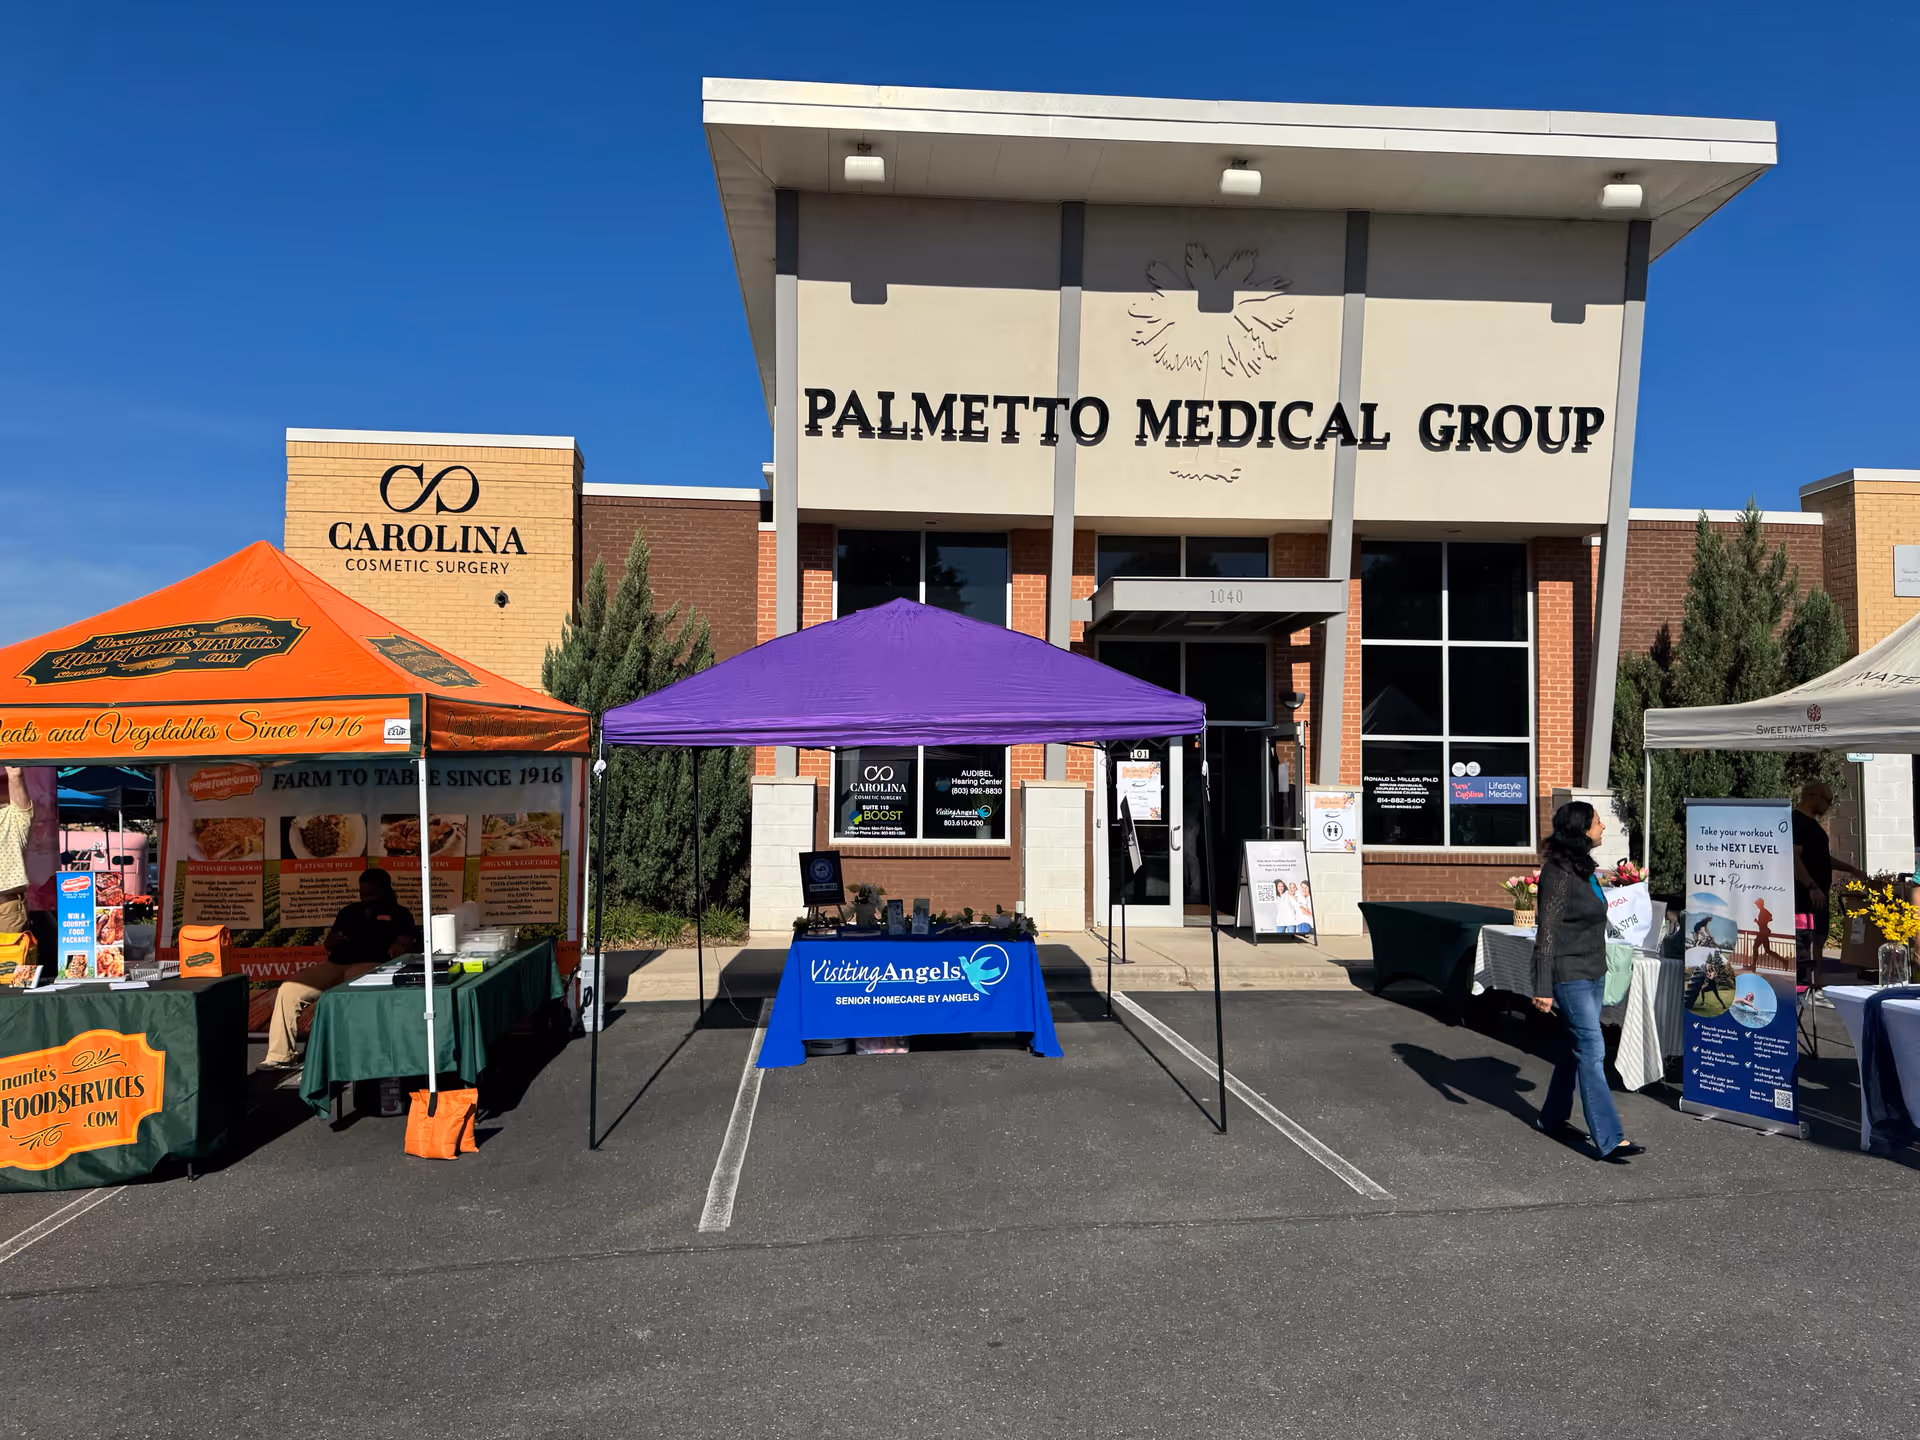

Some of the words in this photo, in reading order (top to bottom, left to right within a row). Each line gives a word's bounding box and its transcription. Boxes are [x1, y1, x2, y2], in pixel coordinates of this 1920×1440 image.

[804, 387, 1110, 447] PALMETTO
[1134, 397, 1391, 451] MEDICAL
[1418, 402, 1605, 454] GROUP
[328, 521, 527, 556] CAROLINA
[345, 558, 429, 572] COSMETIC
[436, 560, 510, 575] SURGERY
[1211, 588, 1243, 604] 1040
[0, 720, 40, 743] eats
[47, 719, 91, 742] and
[93, 711, 220, 751] Vegetables
[224, 710, 299, 742] Since
[304, 716, 364, 740] 1916
[1131, 750, 1148, 759] 101
[272, 770, 330, 791] FARM
[337, 768, 367, 786] TO
[447, 768, 511, 786] SINCE
[519, 766, 563, 785] 1916
[951, 778, 978, 786] Hearing
[850, 782, 907, 793] CAROLINA
[951, 787, 969, 795] (803)
[969, 787, 1003, 795] 992-8830
[1488, 782, 1521, 792] Lifestyle
[1488, 791, 1523, 799] Medicine
[863, 811, 903, 821] BOOST
[1700, 826, 1718, 836] Take
[1719, 829, 1738, 839] your
[1739, 829, 1774, 838] workout
[1706, 843, 1718, 852] the
[1721, 843, 1746, 853] NEXT
[1749, 845, 1779, 855] LEVEL
[1709, 859, 1727, 868] with
[1729, 860, 1764, 870] Purium's
[1694, 874, 1716, 886] ULT
[1719, 877, 1726, 885] +
[1728, 873, 1786, 892] Performance
[67, 912, 79, 920] WIN
[62, 920, 90, 928] GOURMET
[835, 996, 871, 1005] SENIOR
[872, 995, 926, 1005] HOMECARE
[927, 995, 941, 1004] BY
[942, 993, 980, 1003] ANGELS
[1754, 1034, 1776, 1042] Experience
[83, 1110, 118, 1128] .COM
